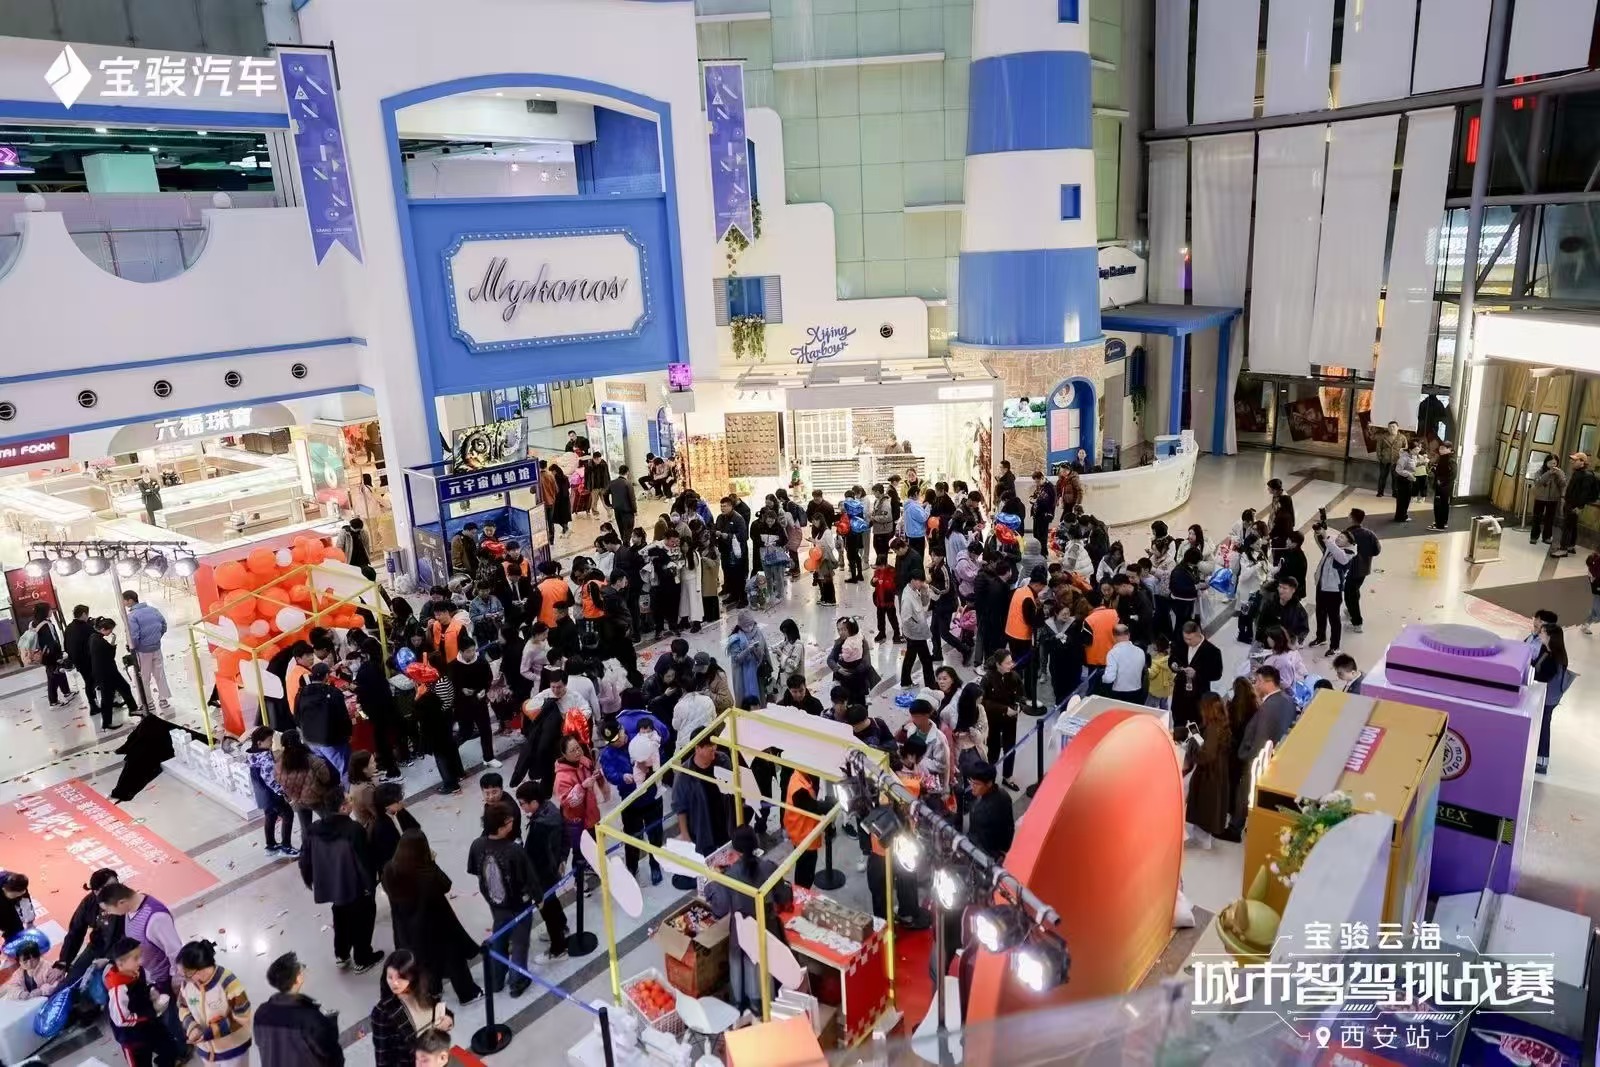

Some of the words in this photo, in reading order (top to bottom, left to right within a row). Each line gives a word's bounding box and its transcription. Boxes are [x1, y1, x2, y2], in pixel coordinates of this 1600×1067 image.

[468, 256, 629, 322] Mykonos
[789, 341, 849, 364] Harbour
[20, 441, 56, 456] FOOK
